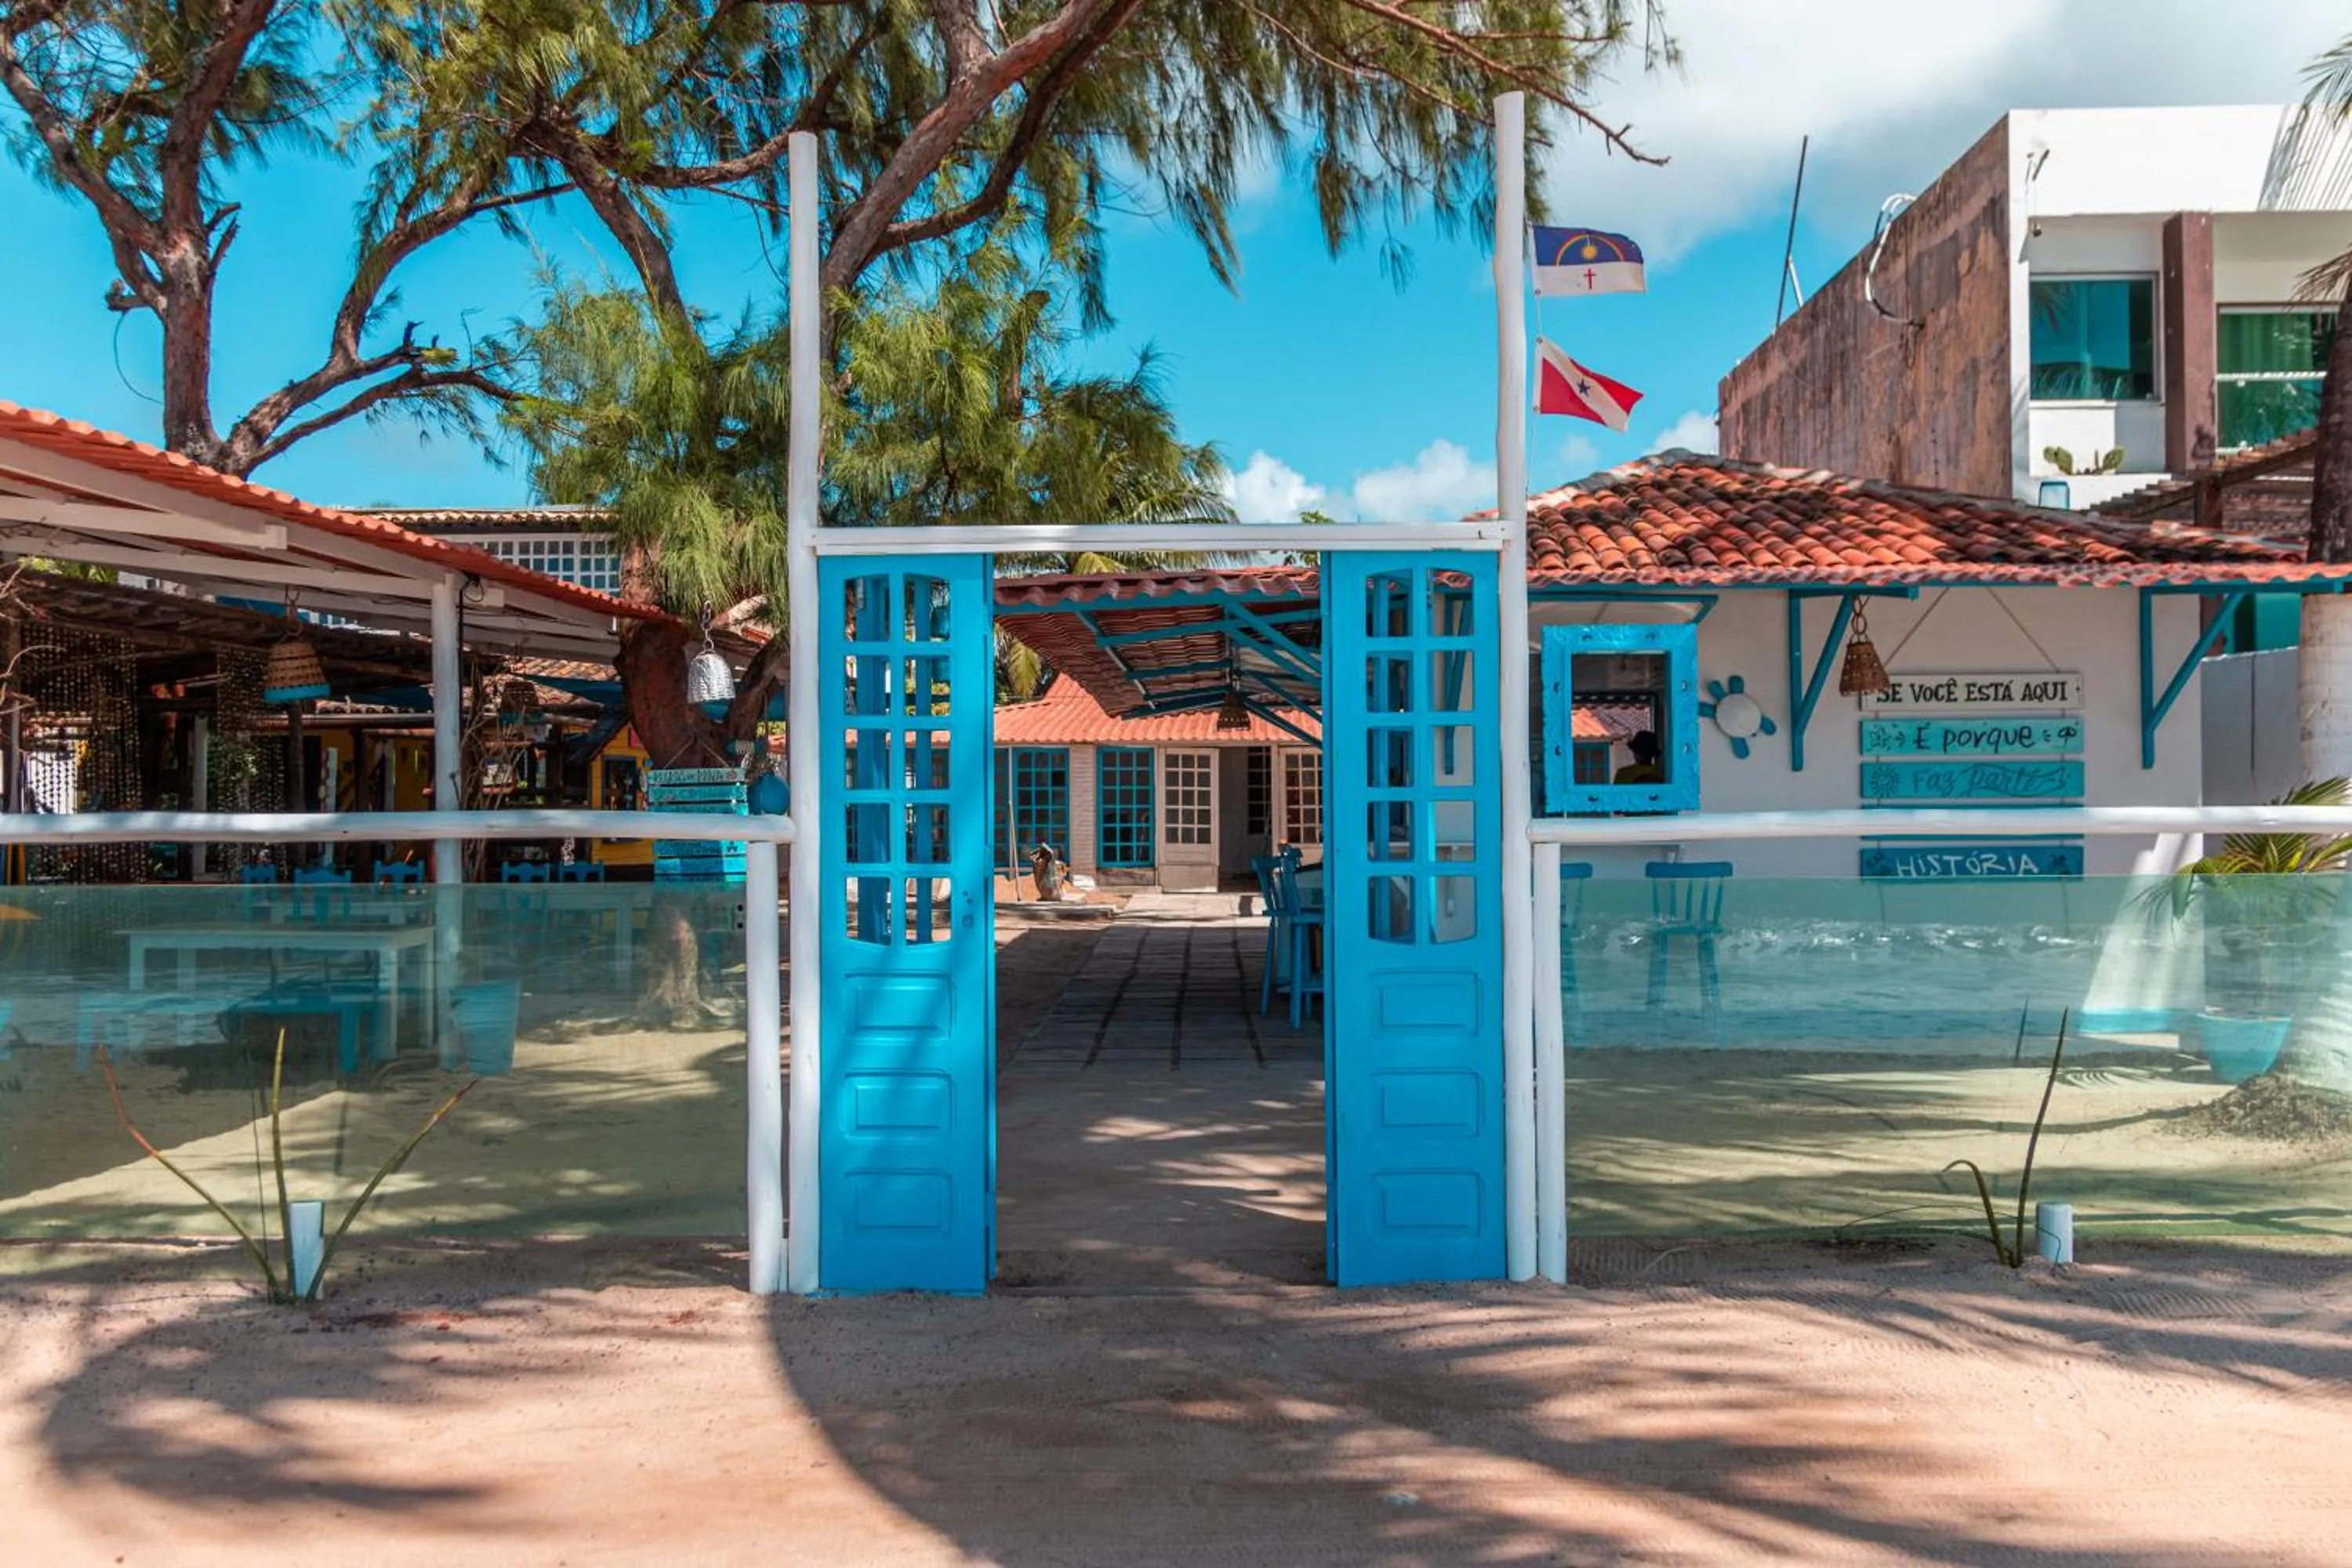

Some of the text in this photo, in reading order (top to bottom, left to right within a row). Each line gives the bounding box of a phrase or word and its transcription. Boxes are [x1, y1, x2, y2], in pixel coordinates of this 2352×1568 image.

[1910, 677, 1958, 702] VOCÊ
[1965, 681, 2013, 702] ESTÁ
[2020, 681, 2068, 702] AQUI
[1915, 721, 2036, 753] É porque
